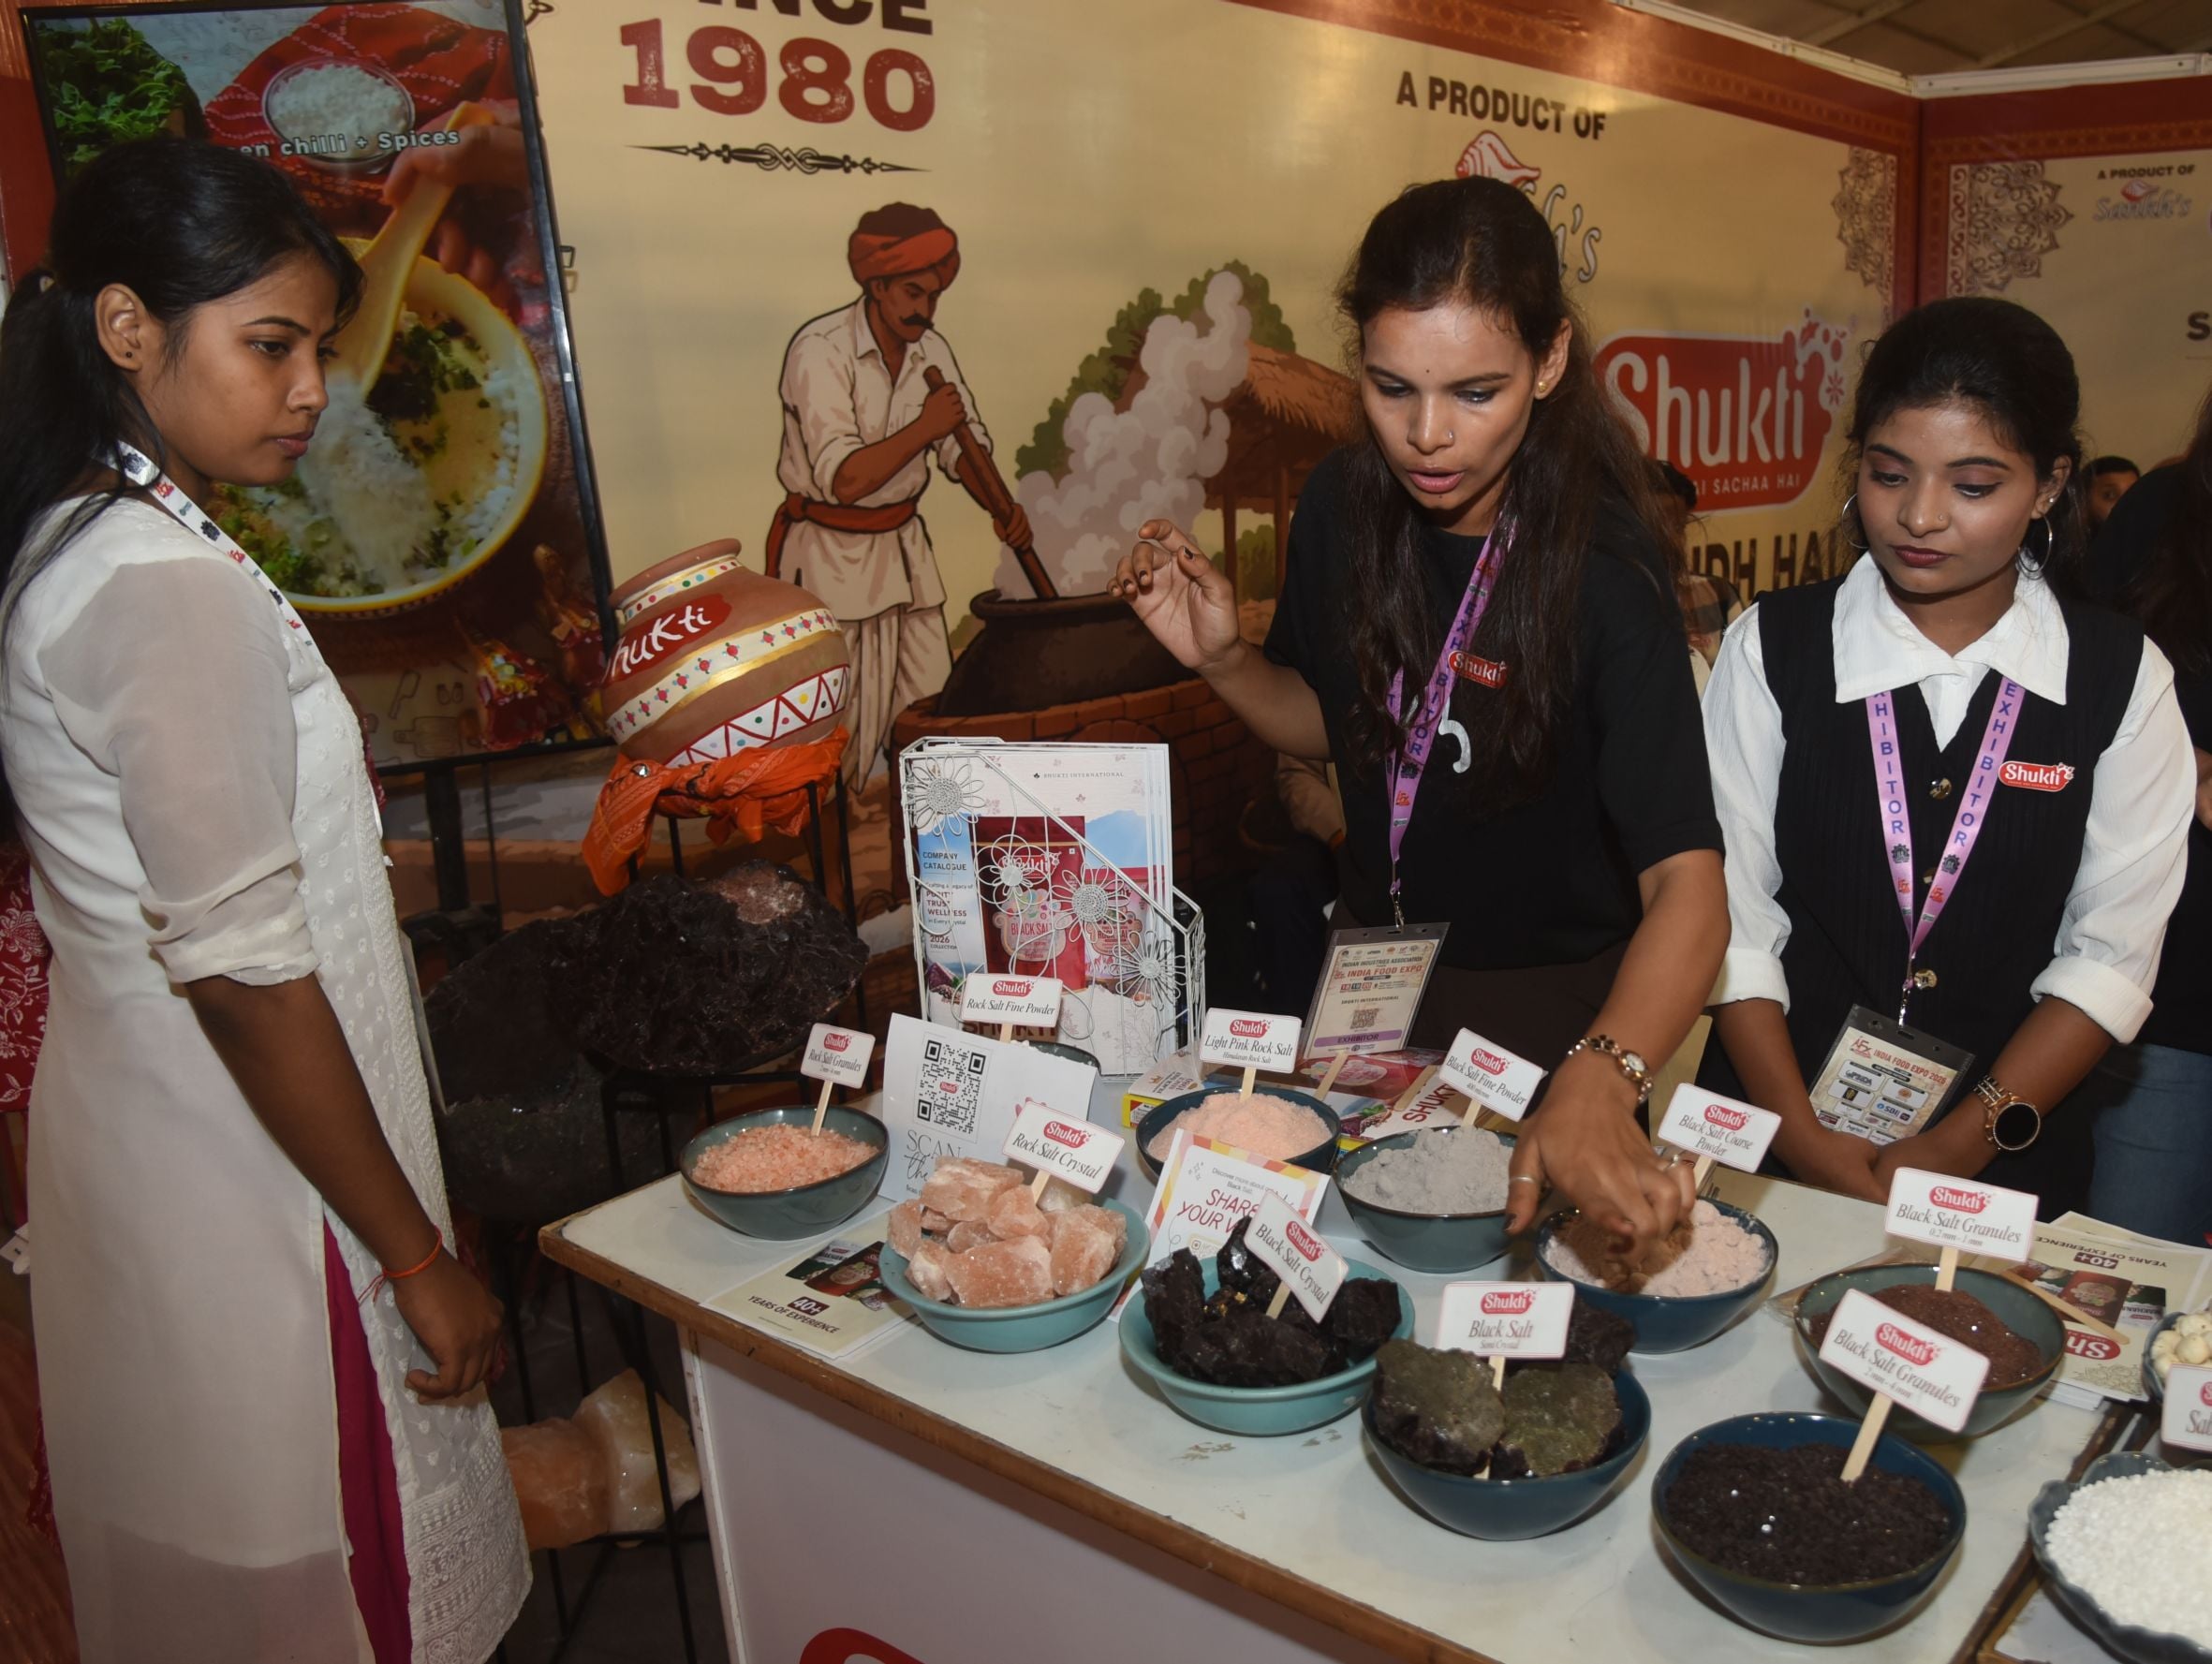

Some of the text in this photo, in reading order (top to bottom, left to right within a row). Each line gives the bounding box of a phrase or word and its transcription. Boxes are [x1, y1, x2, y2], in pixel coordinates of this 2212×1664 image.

[620, 18, 936, 132] 1980
[1396, 71, 1606, 140] A PRODUCT OF
[281, 133, 347, 155] chilli
[378, 129, 460, 153] Spices
[2097, 164, 2195, 180] A PRODUCT OF
[1604, 349, 1804, 469] Shukti
[1713, 476, 1769, 495] SACHAA
[1777, 472, 1800, 488] HAI
[1954, 682, 2017, 847] EXHIBITOR
[2005, 763, 2059, 786] Shukti
[930, 935, 950, 944] 2026
[1348, 965, 1423, 977] INDIA FOOD EXPO
[995, 980, 1026, 994] Shukti
[966, 997, 1055, 1014] Rock Salt Fine Powder
[1232, 1020, 1262, 1035] Shukti
[1337, 1033, 1379, 1044] EXHIBITOR
[1204, 1034, 1294, 1056] Light Pink Rock Salt
[833, 1054, 862, 1072] Granules
[1473, 1049, 1501, 1074] Shukti
[1873, 1049, 1891, 1062] INDIA
[1892, 1055, 1910, 1070] FOOD
[1910, 1064, 1929, 1076] EXPO
[1927, 1072, 1947, 1084] 2026
[1447, 1055, 1466, 1075] Black
[1465, 1062, 1482, 1082] Salt
[1478, 1069, 1497, 1091] Fine
[1497, 1081, 1527, 1106] Powder
[1678, 1114, 1704, 1135] Black
[1705, 1124, 1725, 1141] Salt
[1706, 1105, 1743, 1127] Shukti
[1047, 1122, 1080, 1146] Shukti
[1012, 1132, 1102, 1179] Rock Salt Crystal
[1695, 1136, 1728, 1157] Powder
[1933, 1187, 1980, 1210] Shukti
[1176, 1200, 1224, 1230] YOUR
[1895, 1203, 2022, 1244] Black Salt Granules
[1289, 1220, 1319, 1259] Shukti
[1928, 1228, 1941, 1238] 0.2
[2035, 1235, 2107, 1256] EXPERIENCE
[1255, 1223, 1290, 1254] Black
[1282, 1247, 1301, 1274] Salt
[1299, 1266, 1330, 1305] Crystal
[2077, 1253, 2113, 1267] 40+
[2129, 1256, 2168, 1268] YEARS
[793, 1298, 823, 1316] 40+
[1484, 1292, 1526, 1310] Shukti
[748, 1295, 840, 1334] YEARS OF EXPERIENCE
[1468, 1319, 1534, 1338] Black Salt
[1877, 1323, 1927, 1361] Shukti
[1833, 1329, 1961, 1408] Black Salt Granules
